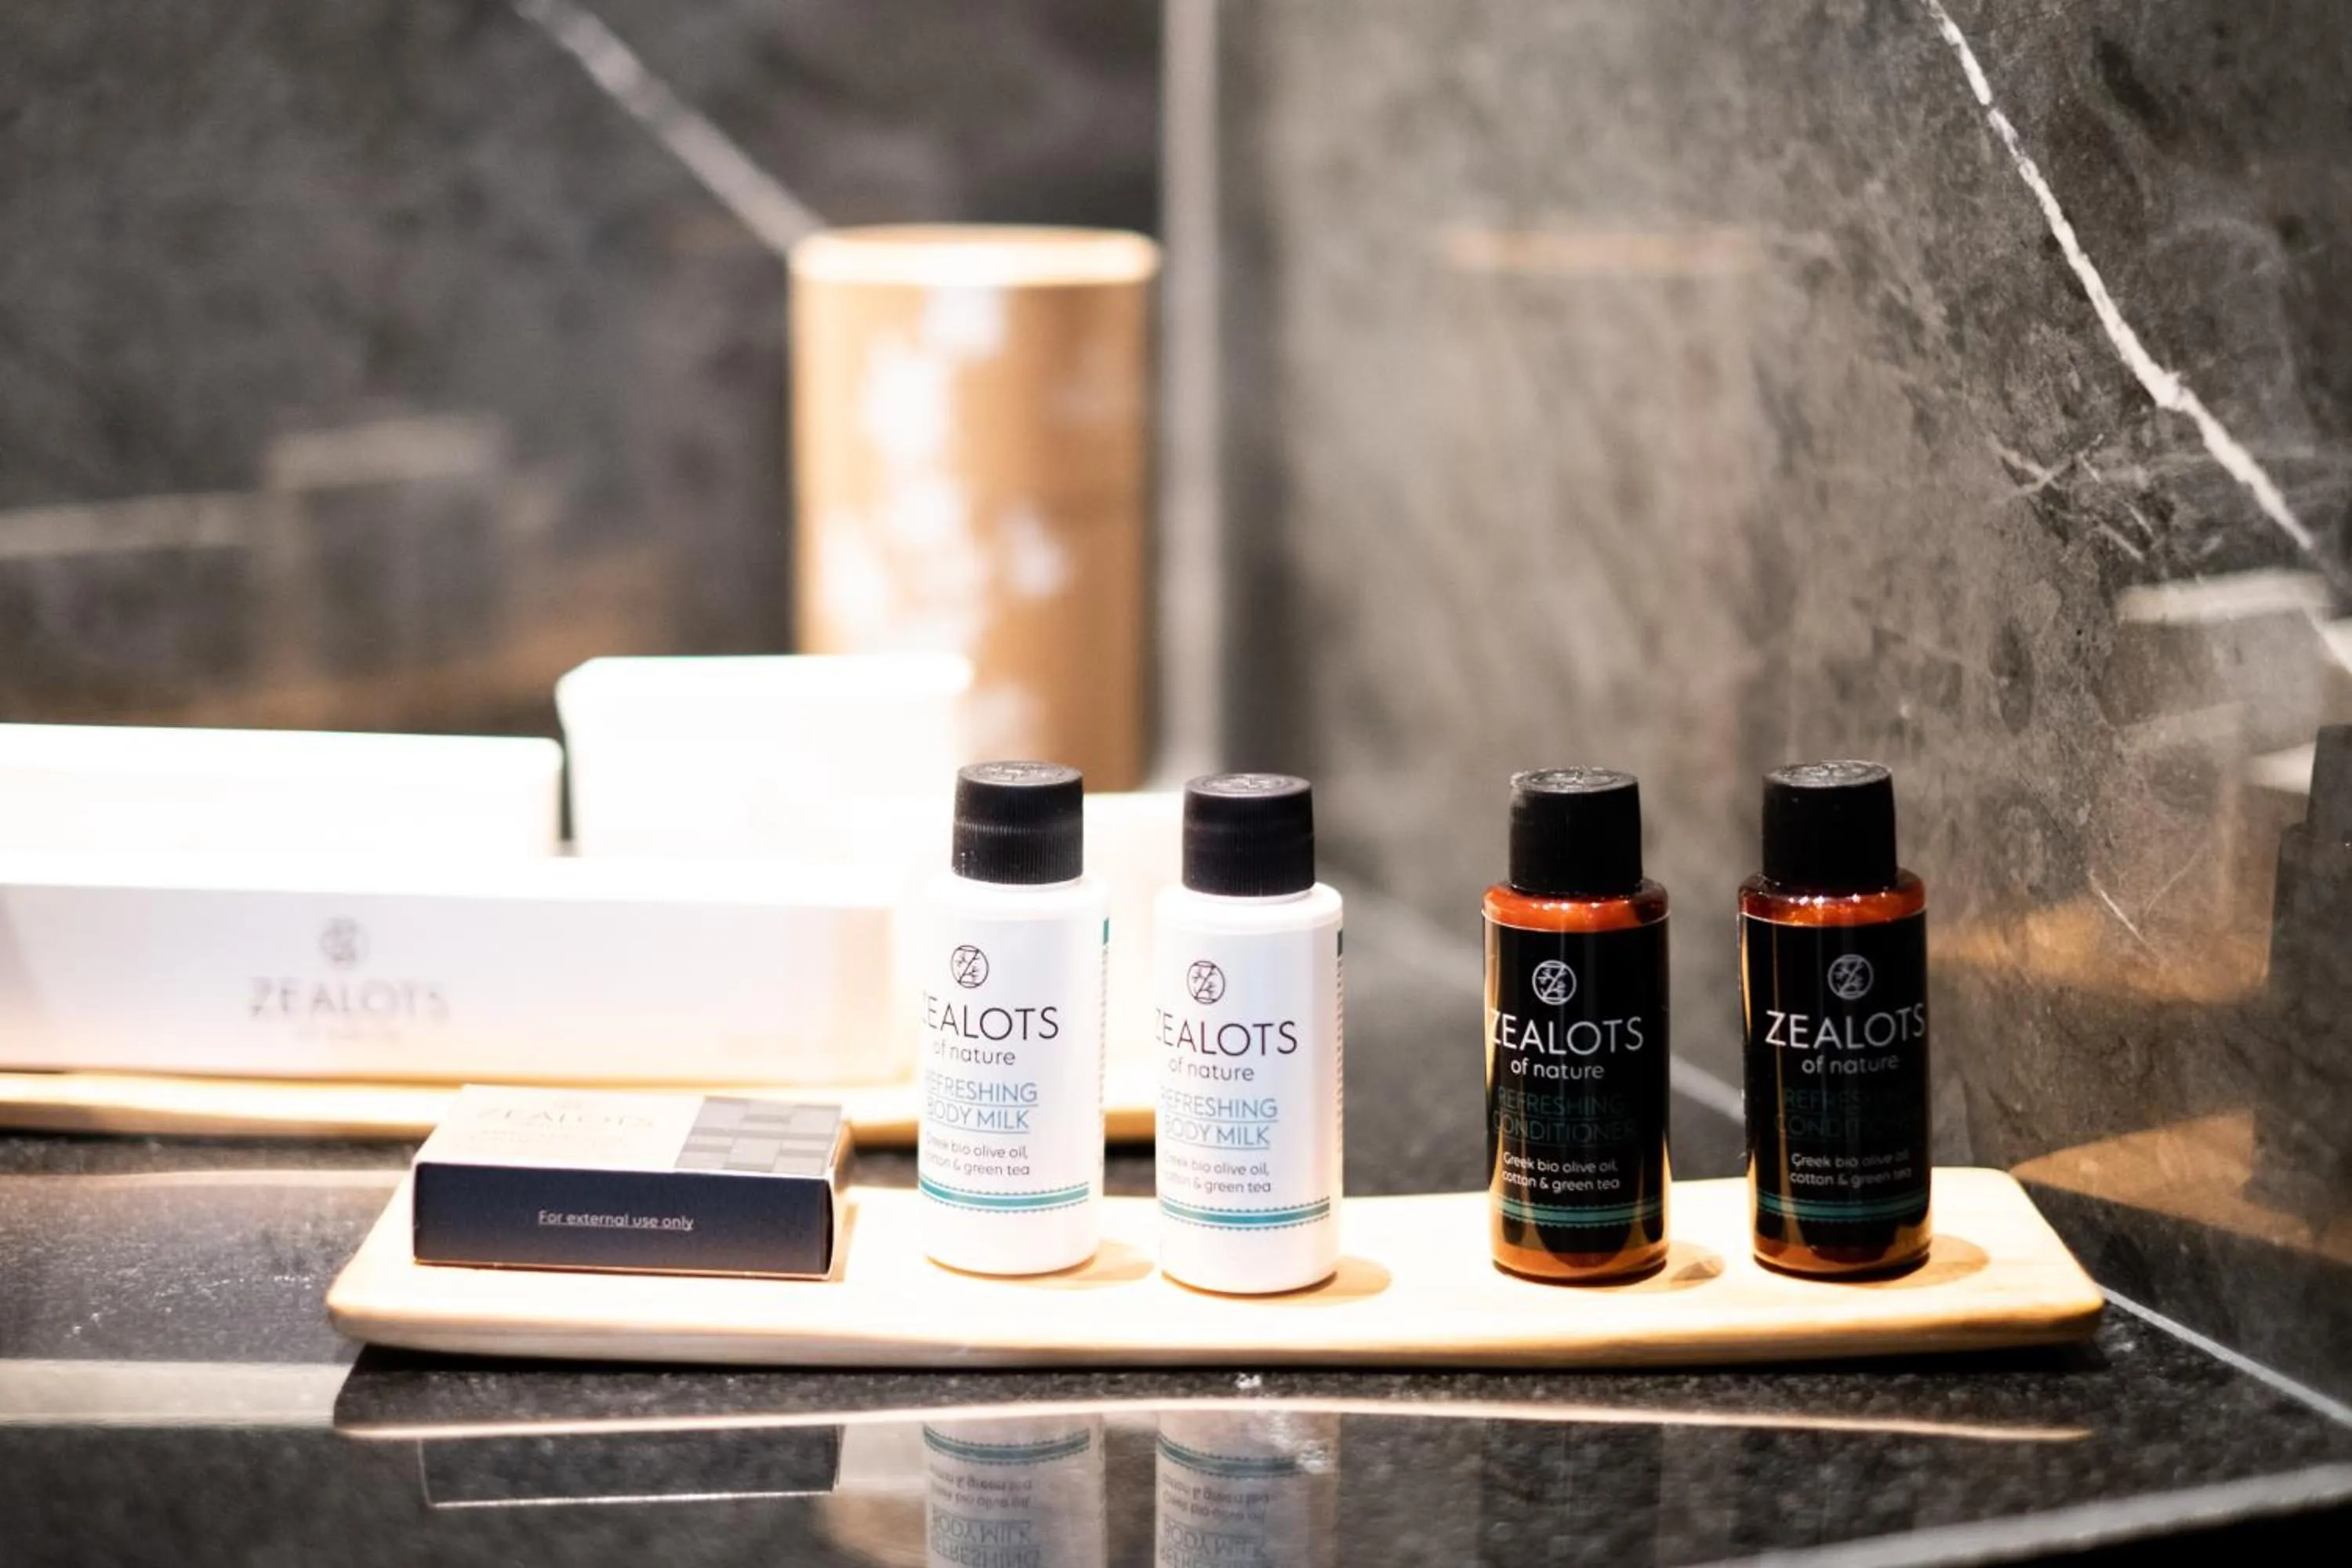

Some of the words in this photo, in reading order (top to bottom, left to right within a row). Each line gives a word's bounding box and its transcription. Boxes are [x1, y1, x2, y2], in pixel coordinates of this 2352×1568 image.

[1490, 1007, 1643, 1055] ZEALOTS
[1765, 1004, 1926, 1050] ZEALOTS
[949, 1045, 1016, 1065] nature
[1802, 1054, 1824, 1075] of
[1829, 1054, 1900, 1074] nature
[1187, 1062, 1255, 1082] nature
[1511, 1057, 1529, 1076] of
[1533, 1062, 1605, 1080] nature
[1498, 1085, 1626, 1116] REFRESHING
[977, 1109, 1029, 1129] MILK
[1493, 1109, 1639, 1142] CONDITIONER
[1217, 1125, 1270, 1145] MILK
[973, 1144, 1005, 1159] olive
[1791, 1152, 1831, 1168] Greek
[1835, 1155, 1859, 1168] bio
[964, 1162, 1003, 1176] green
[1007, 1163, 1031, 1176] tea
[1214, 1162, 1247, 1175] olive
[1504, 1151, 1535, 1171] Greek
[1537, 1156, 1560, 1174] bio
[1562, 1158, 1597, 1174] olive
[1204, 1180, 1244, 1194] green
[1247, 1181, 1271, 1193] tea
[1501, 1170, 1537, 1188] cotton
[1539, 1177, 1550, 1189] &
[1552, 1179, 1594, 1196] green
[1597, 1178, 1621, 1191] tea
[1790, 1172, 1834, 1185] cotton
[1850, 1172, 1891, 1189] green
[539, 1210, 562, 1225] For
[566, 1213, 628, 1228] external
[633, 1216, 659, 1229] use
[662, 1215, 694, 1232] only
